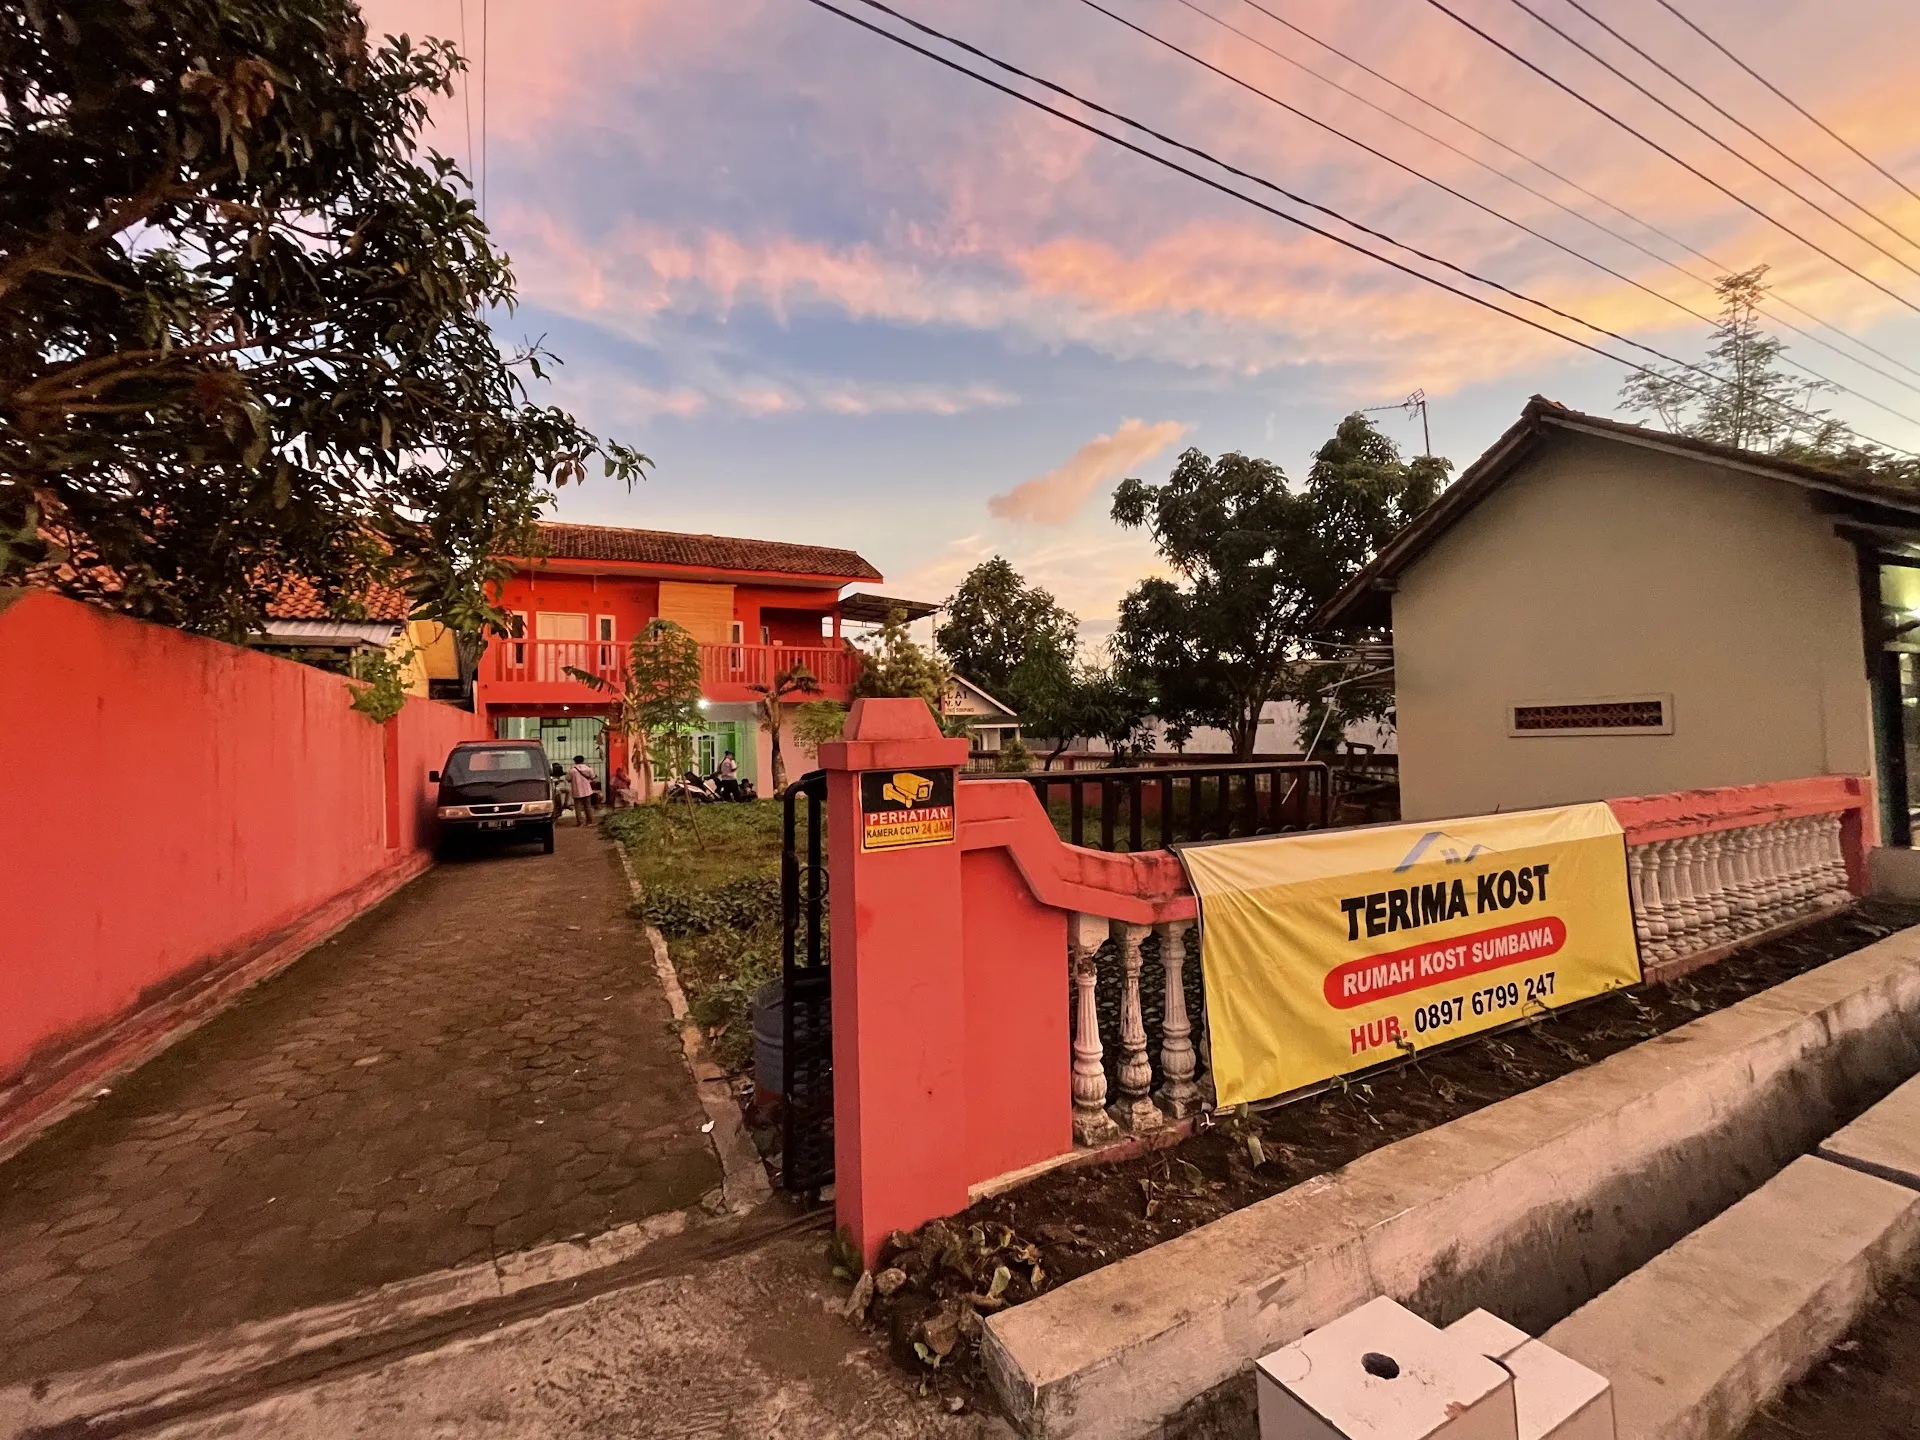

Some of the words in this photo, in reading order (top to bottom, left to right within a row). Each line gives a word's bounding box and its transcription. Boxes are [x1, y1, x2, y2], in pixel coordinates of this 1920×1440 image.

[866, 828, 899, 838] KAMERA
[900, 825, 920, 836] CCTV
[921, 823, 932, 835] 24
[933, 820, 952, 833] JAM
[869, 807, 949, 825] PERHATIAN
[1341, 878, 1470, 942] TERIMA
[1477, 863, 1550, 914] KOST
[1343, 957, 1415, 997] RUMAH
[1420, 945, 1467, 977] KOST
[1471, 926, 1554, 963] SUMBAWA
[1414, 996, 1465, 1033] 0897
[1471, 982, 1519, 1016] 6799
[1524, 971, 1556, 1001] 247
